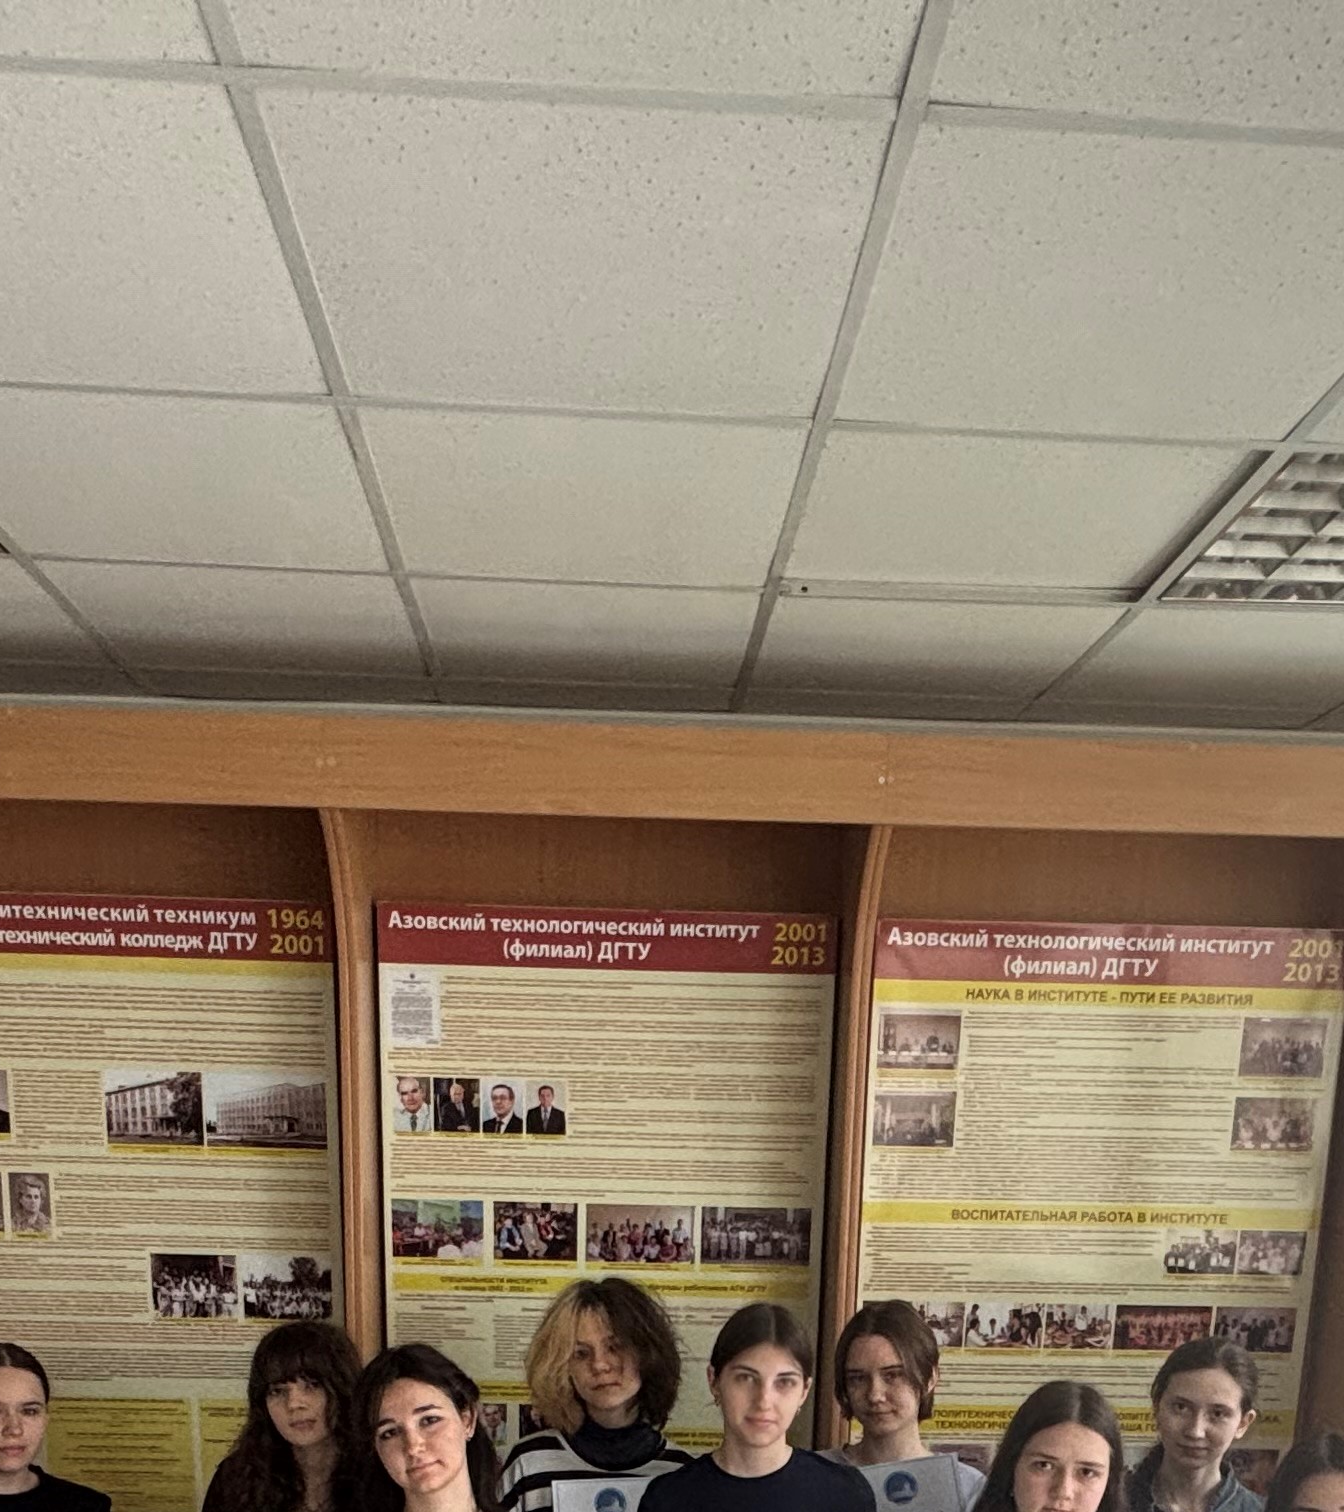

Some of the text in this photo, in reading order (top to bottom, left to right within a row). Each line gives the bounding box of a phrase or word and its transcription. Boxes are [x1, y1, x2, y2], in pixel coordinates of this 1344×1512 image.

[153, 908, 256, 930] техникум
[267, 908, 324, 929] 1964
[388, 910, 761, 942] Азовский технологический институт
[120, 932, 204, 952] колледж
[207, 931, 258, 953] ДГТУ
[775, 922, 827, 942] 2001
[270, 934, 324, 955] 2001
[503, 938, 652, 963] (филиал) ДГТУ
[887, 926, 1275, 960] Азовский технологический институт
[1288, 938, 1344, 959] 2001
[770, 946, 825, 966] 2013
[1003, 954, 1159, 980] (филиал) ДГТУ
[1282, 962, 1341, 983] 2013
[965, 988, 1010, 1000] НАУКА
[1014, 988, 1024, 1000] В
[1027, 989, 1108, 1002] ИНСТИТУТЕ
[1120, 991, 1155, 1003] ПУТИ
[1159, 991, 1176, 1003] ЕЕ
[1180, 992, 1253, 1006] РАЗВИТИЯ
[951, 1209, 1229, 1225] ВОСПИТАТЕЛЬНАЯ РАБОТА В ИНСТИТУТЕ
[933, 1409, 1014, 1419] ПОЛИТЕХНИЧЕС
[935, 1420, 1009, 1429] ТЕХНОЛОГИЧЕ
